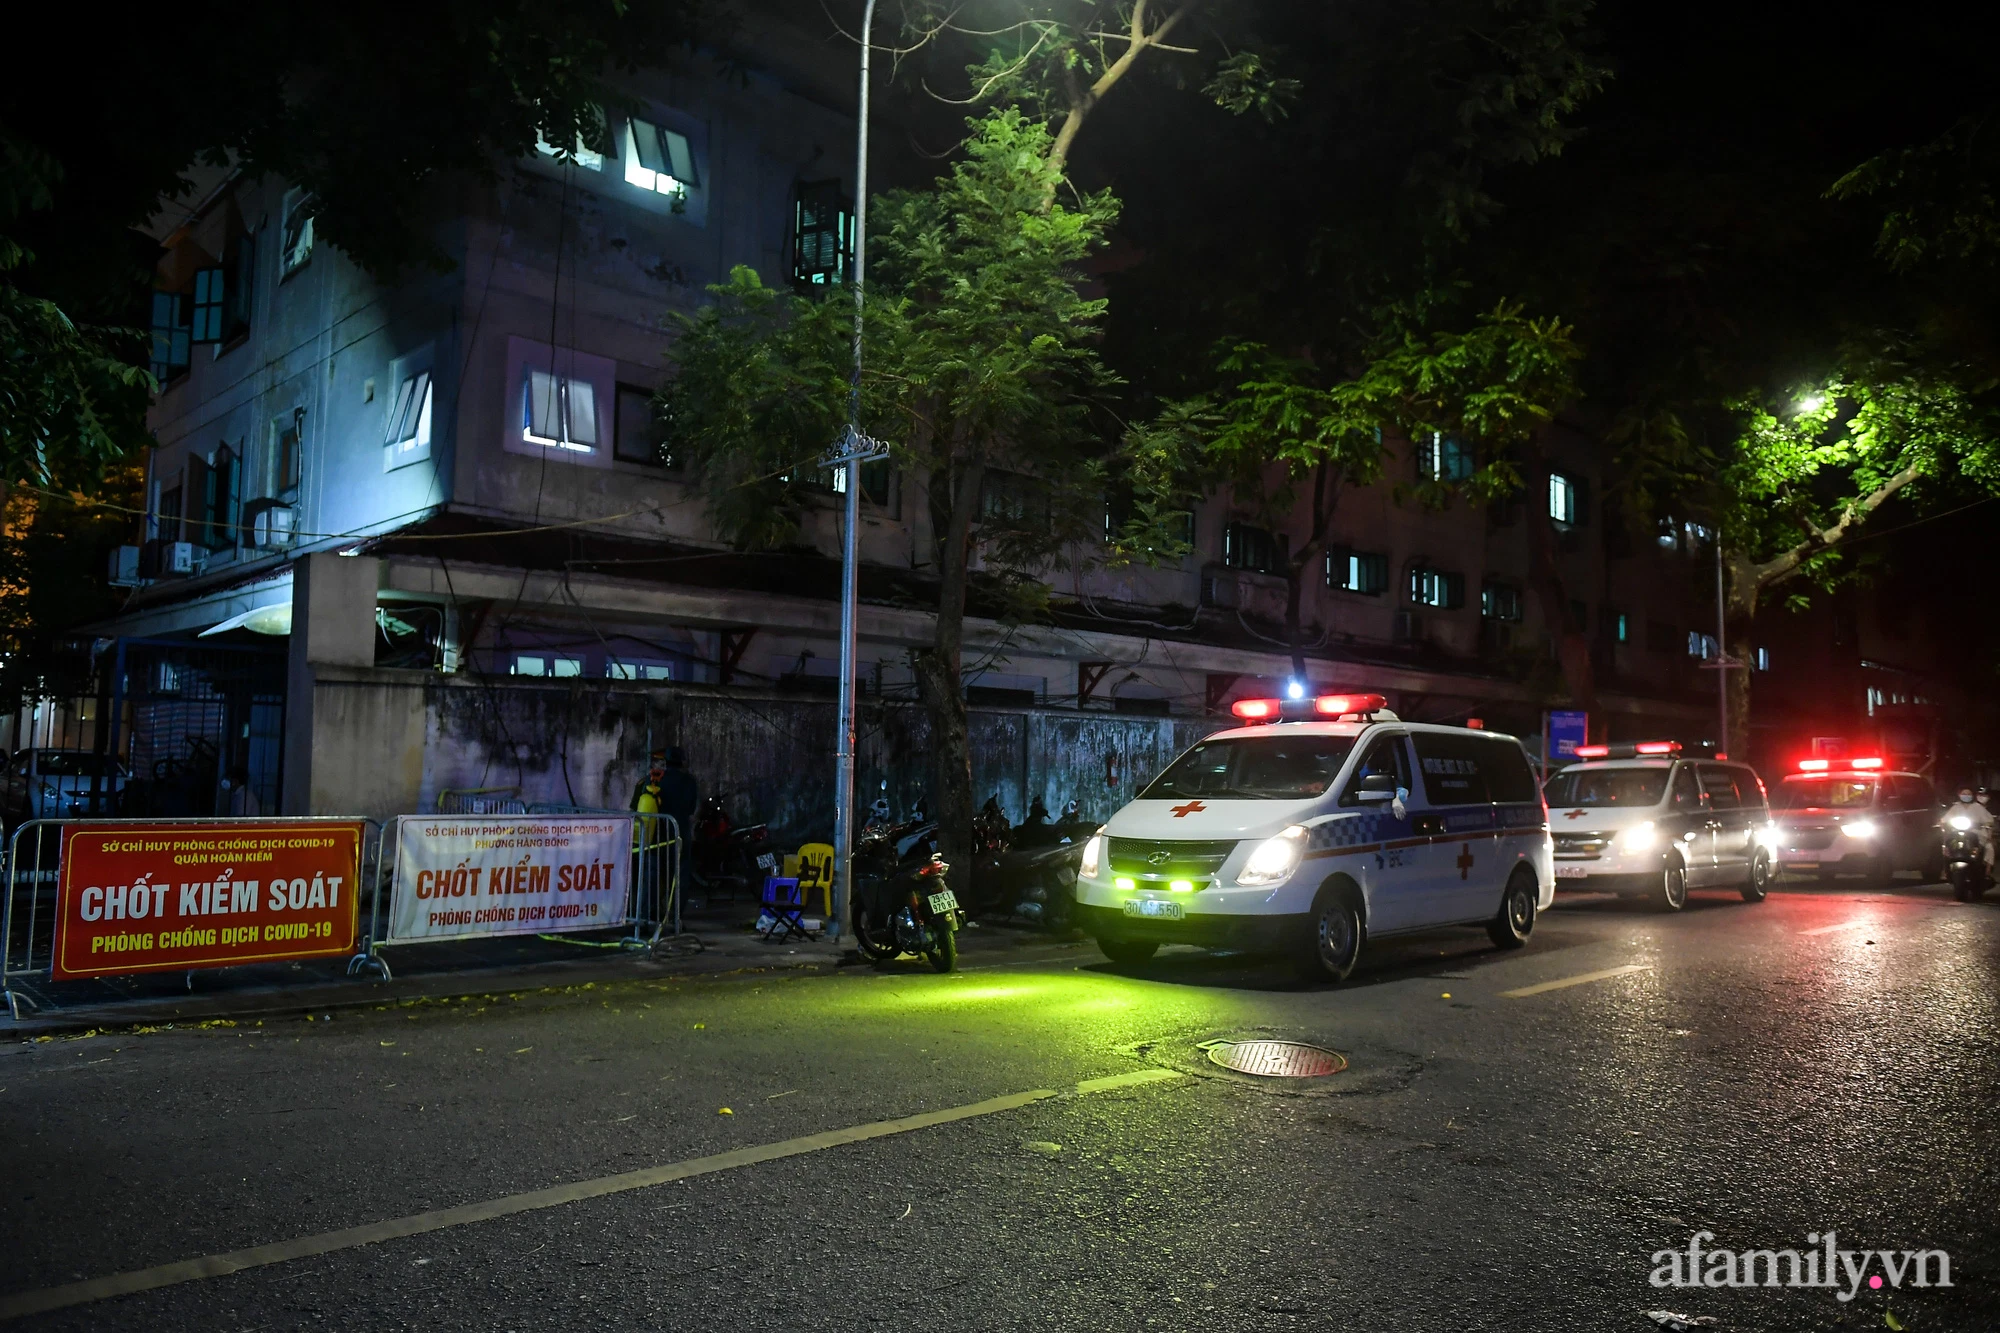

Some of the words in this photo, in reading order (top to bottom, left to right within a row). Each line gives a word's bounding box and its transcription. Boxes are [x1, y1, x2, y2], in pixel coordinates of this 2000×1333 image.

[426, 825, 439, 836] SỞ
[461, 827, 479, 836] HUY
[483, 826, 514, 835] PHÒNG
[517, 824, 549, 835] CHỐNG
[552, 826, 571, 836] DỊCH
[574, 826, 613, 834] COVID-19
[102, 840, 119, 852] SỞ
[122, 840, 143, 851] CHỈ
[146, 842, 170, 851] HUY
[174, 839, 215, 850] PHÒNG
[217, 838, 257, 850] CHỐNG
[260, 839, 285, 850] DỊCH
[288, 839, 334, 848] COVID-19
[517, 837, 542, 847] HÀNG
[174, 852, 207, 865] QUẬN
[210, 850, 243, 863] HOÀN
[246, 849, 272, 862] KIẾM
[416, 858, 481, 899] CHỐT
[489, 855, 550, 894] KIỂM
[558, 858, 614, 891] SOÁT
[80, 873, 169, 922] CHỐT
[179, 868, 259, 916] KIỂM
[269, 871, 342, 911] SOÁT
[429, 909, 471, 926] PHÒNG
[475, 904, 514, 923] CHỐNG
[518, 906, 545, 923] DỊCH
[549, 904, 597, 919] COVID-19
[92, 931, 153, 953] PHÒNG
[159, 925, 216, 948] CHỐNG
[222, 926, 258, 947] DỊCH
[265, 922, 332, 941] COVID-19
